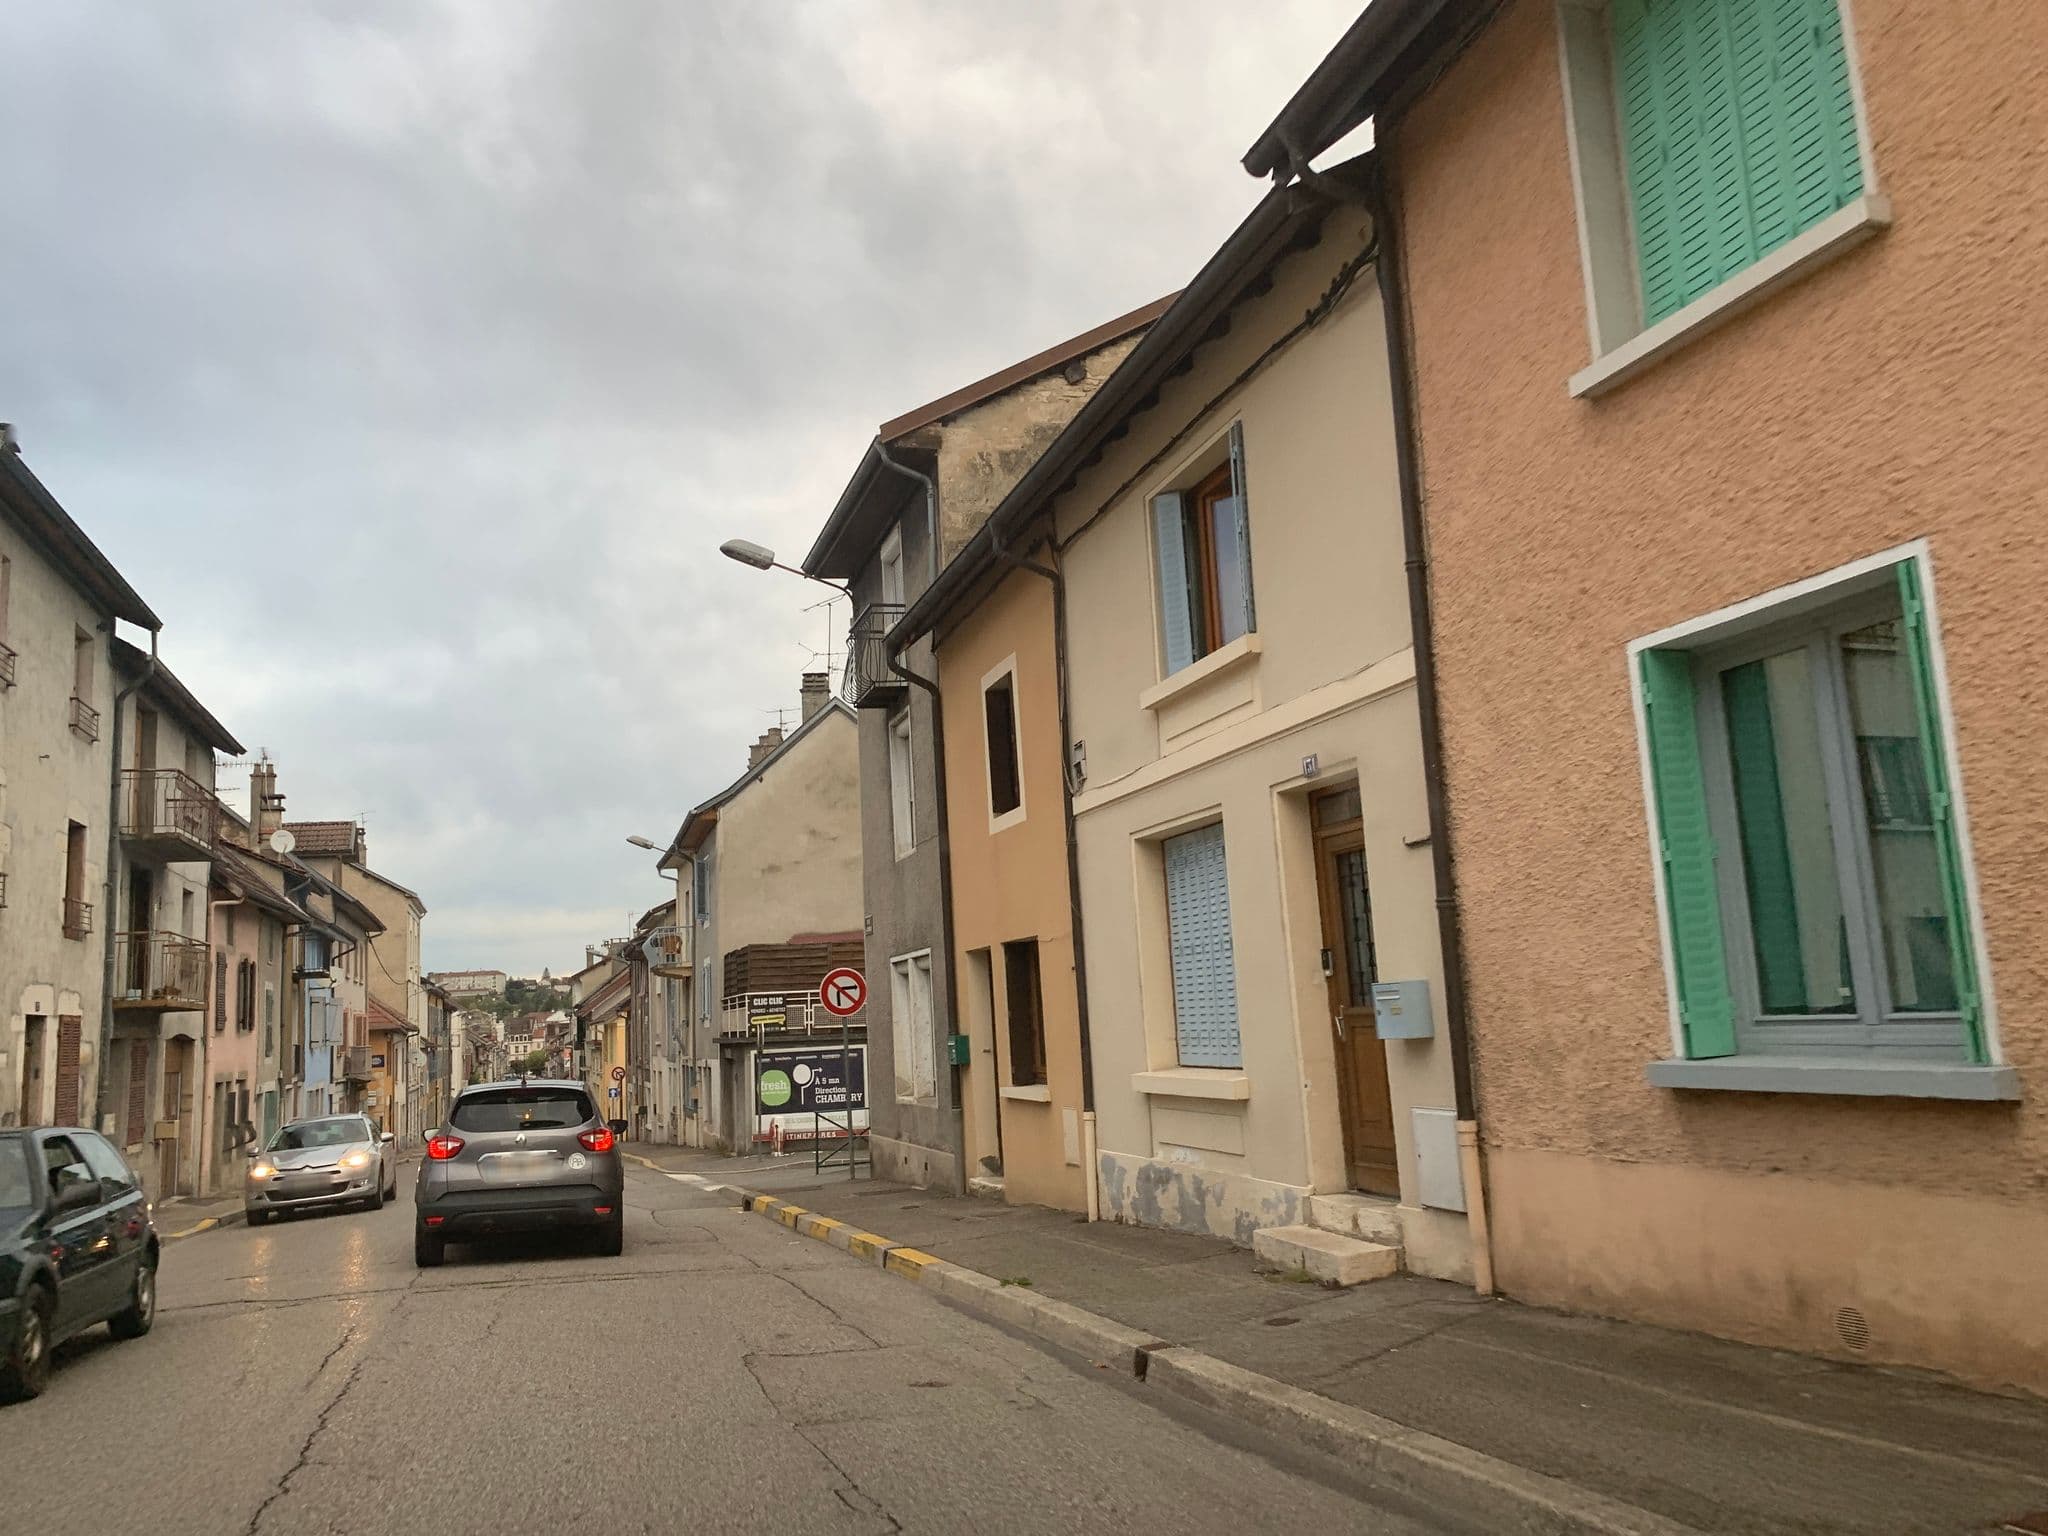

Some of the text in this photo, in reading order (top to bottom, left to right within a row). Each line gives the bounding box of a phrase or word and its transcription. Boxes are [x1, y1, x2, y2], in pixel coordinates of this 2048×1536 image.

[753, 996, 784, 1006] CLIC CLIC
[815, 1086, 847, 1095] Direction
[815, 1093, 863, 1104] CHAMBRY
